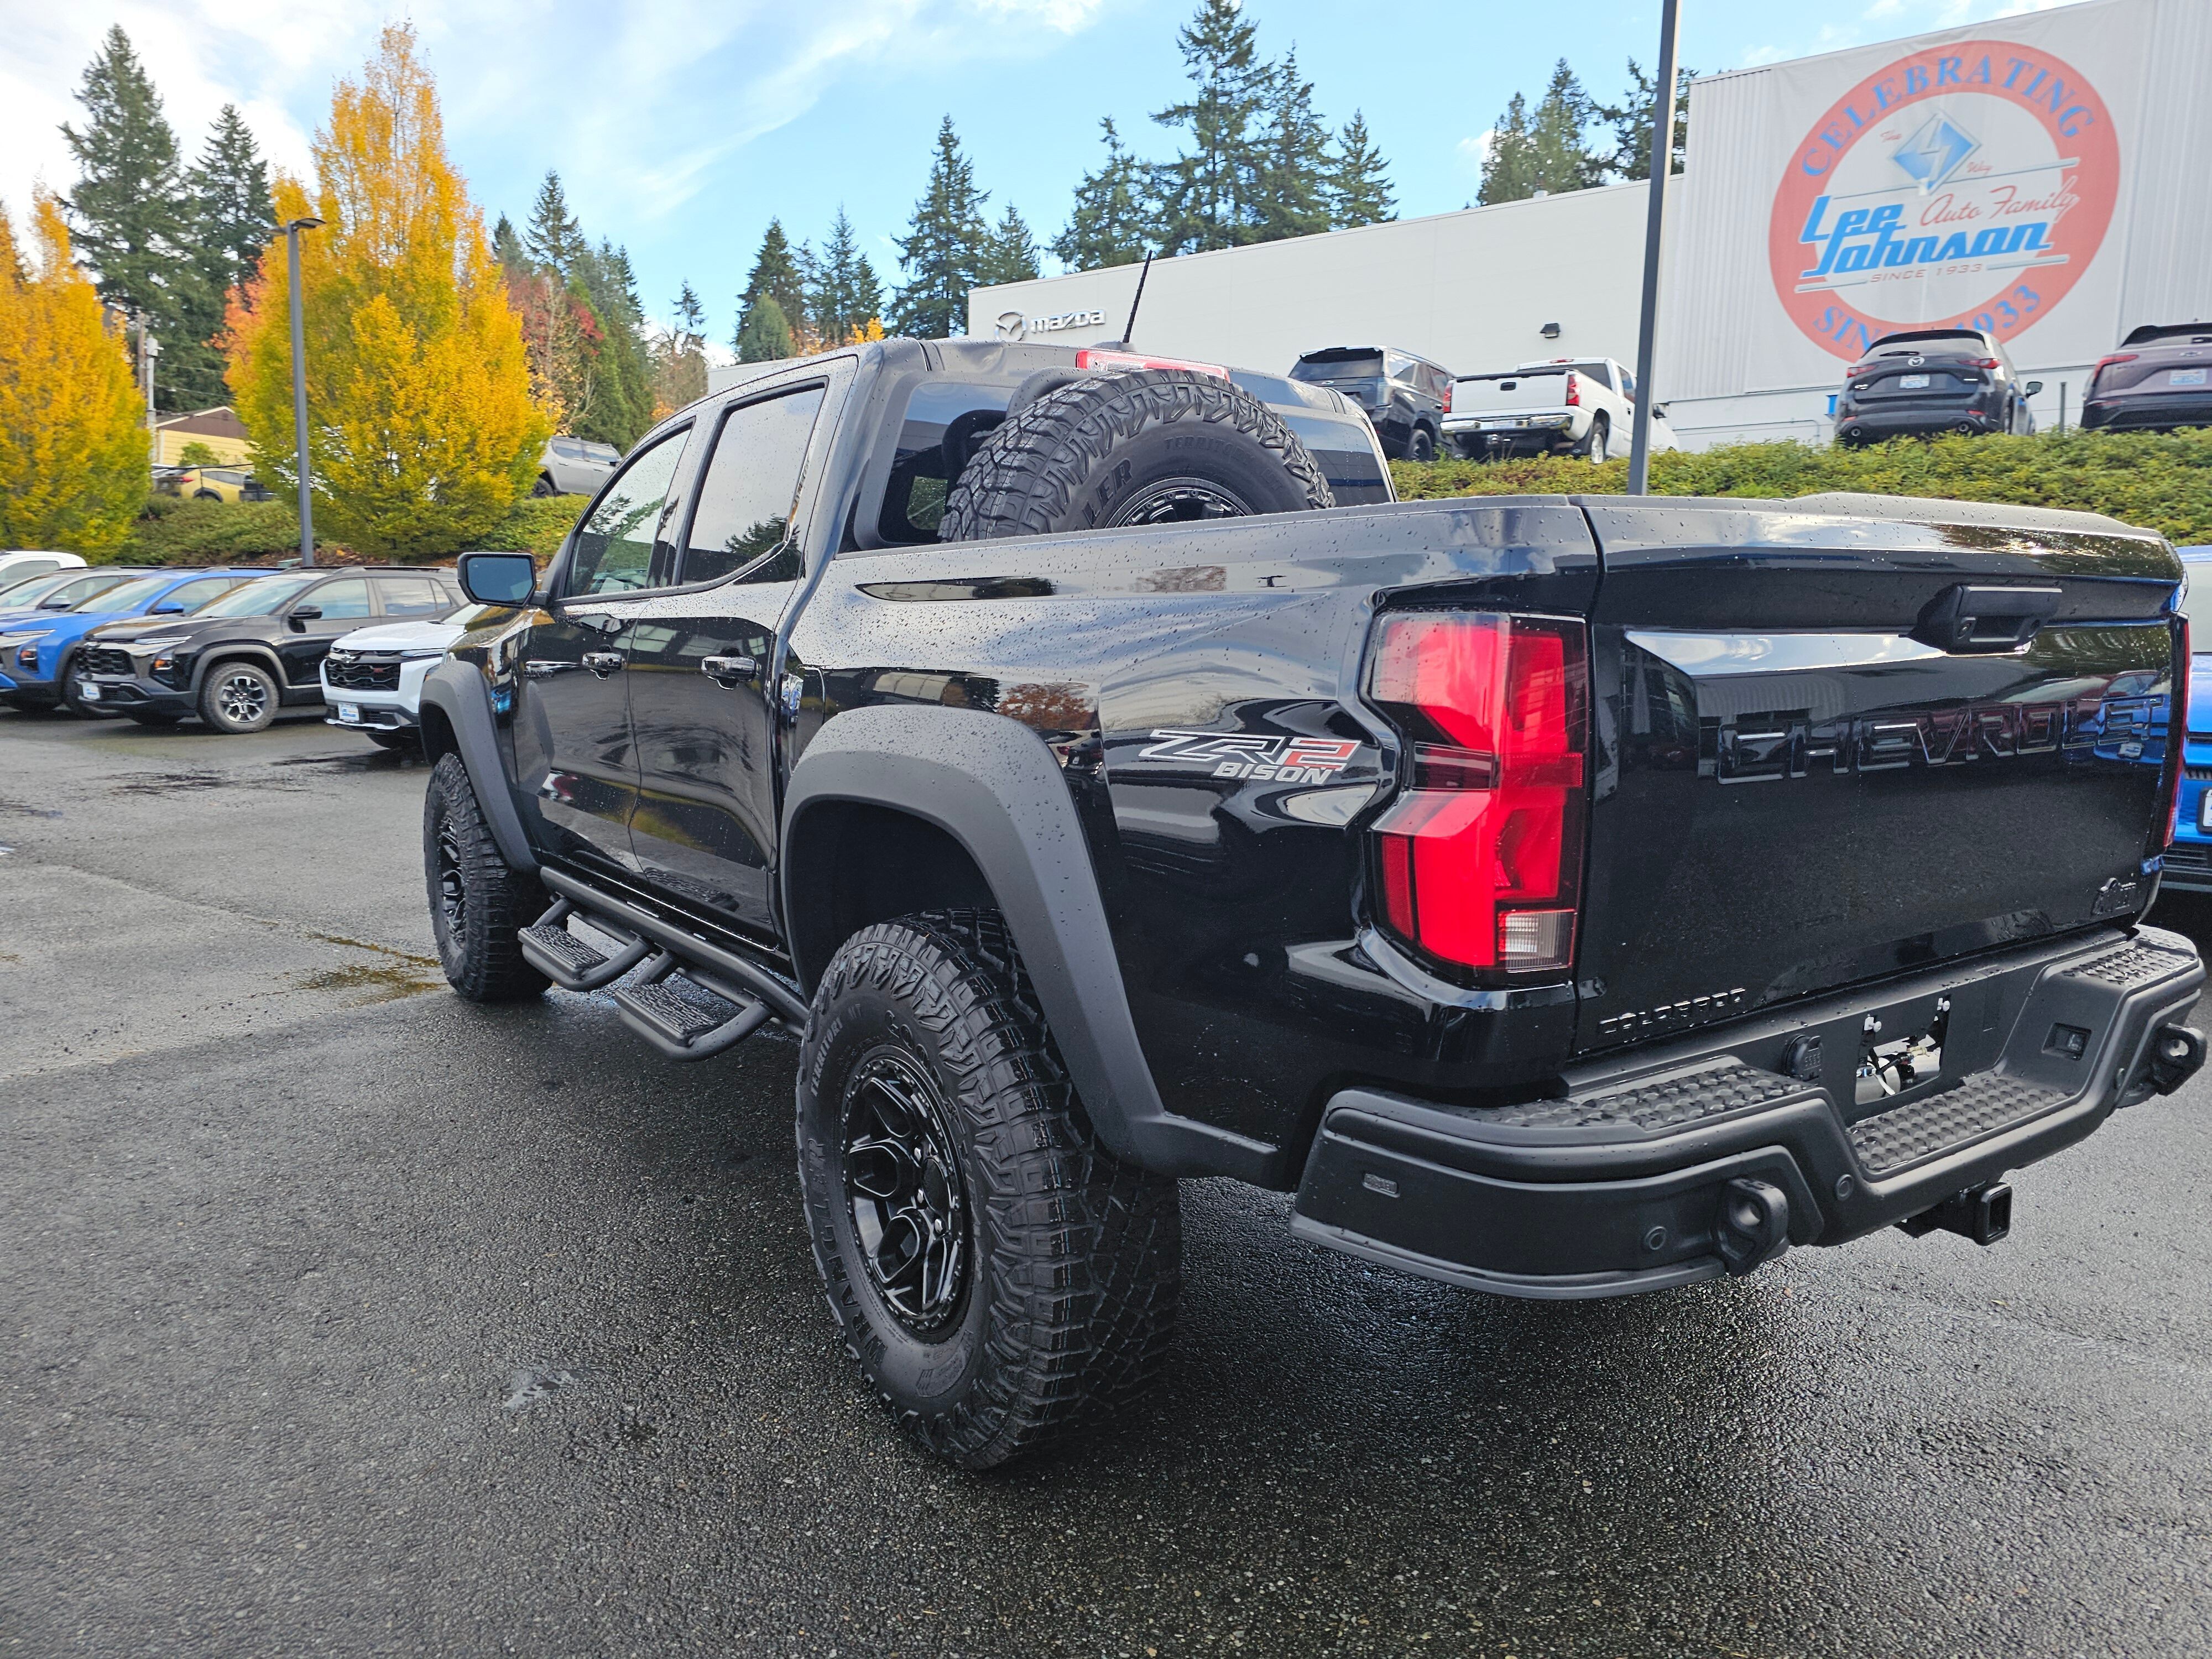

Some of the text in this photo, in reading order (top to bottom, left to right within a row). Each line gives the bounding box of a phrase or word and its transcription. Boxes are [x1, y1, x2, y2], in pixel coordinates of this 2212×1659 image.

[1801, 55, 2095, 177] CELEBRATING
[1798, 195, 1907, 243] Lee
[1920, 175, 2080, 227] Auto Family
[1800, 221, 2054, 279] Johnson
[1870, 263, 1983, 283] SINCE 1933
[1030, 308, 1106, 334] mazda
[1813, 305, 1887, 353] SIN
[1138, 729, 1362, 772] ZR2
[1718, 695, 2164, 784] CHEVROLET
[1213, 761, 1333, 785] BISON
[807, 1138, 888, 1367] WRANGLER
